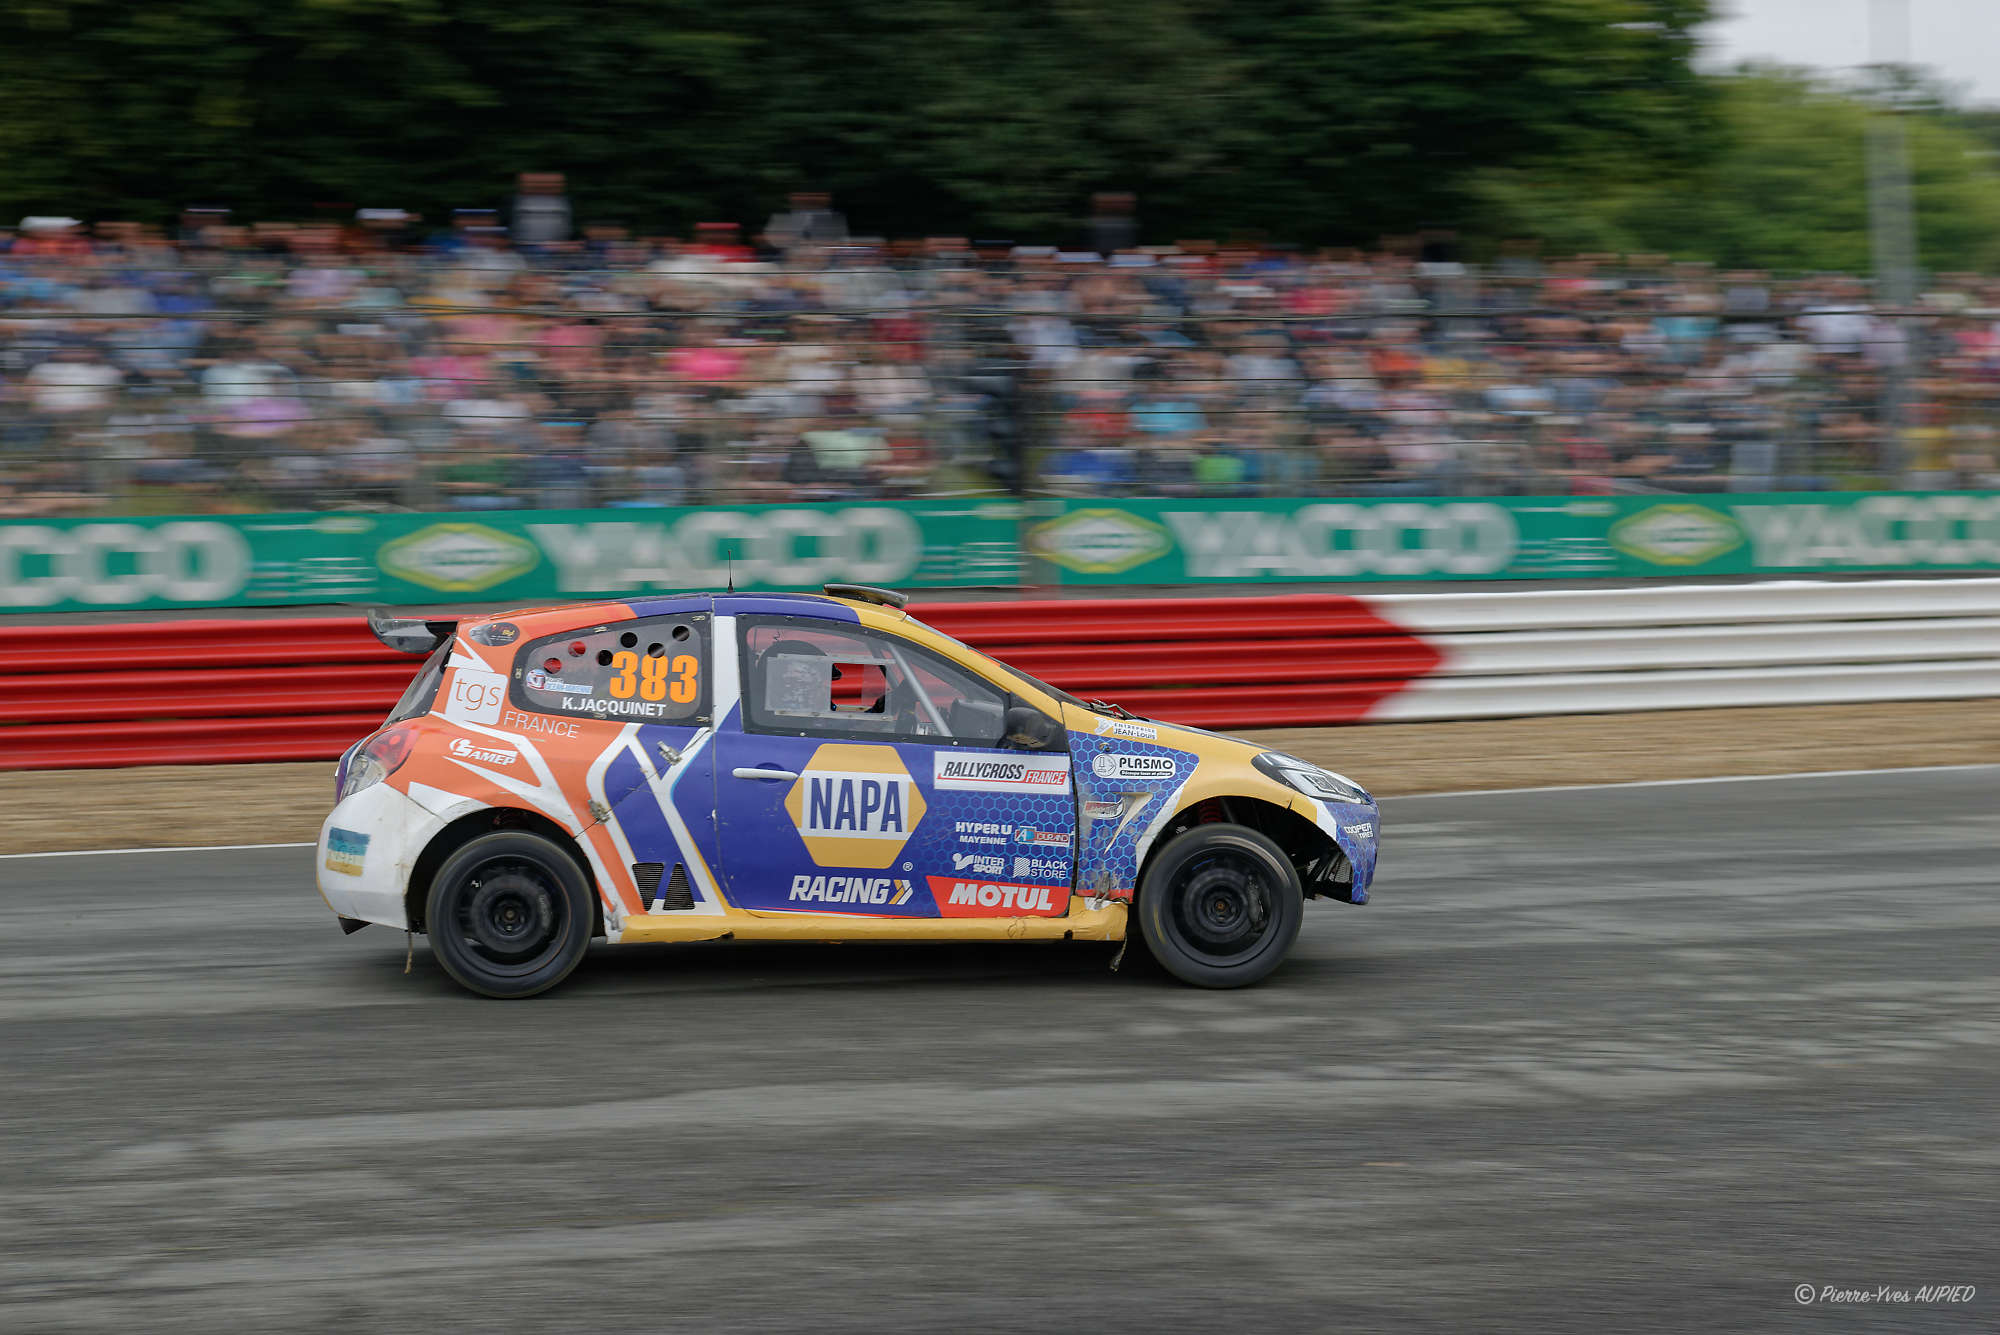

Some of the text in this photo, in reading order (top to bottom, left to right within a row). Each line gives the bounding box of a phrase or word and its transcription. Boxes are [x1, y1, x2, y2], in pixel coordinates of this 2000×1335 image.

[526, 507, 923, 592] YACCO
[1160, 502, 1519, 577] YACCO
[609, 650, 698, 704] 383
[455, 678, 501, 711] tgs
[562, 697, 666, 716] K.JACQUINET
[504, 711, 581, 738] FRANCE
[1114, 728, 1156, 739] JEAN-LOUIS
[451, 738, 518, 765] SAMEP
[944, 761, 1066, 784] RALLYCROSS FRANCE
[1119, 757, 1173, 770] PLASMO
[810, 778, 902, 832] NAPA
[956, 822, 1013, 835] HYPER U
[959, 835, 1008, 846] MAYENNE
[973, 864, 1004, 875] SPORT
[974, 855, 1005, 867] INTER
[1031, 859, 1068, 870] BLACK
[1030, 868, 1067, 879] STORE
[789, 875, 891, 905] RACING
[948, 883, 1053, 910] MOTUL
